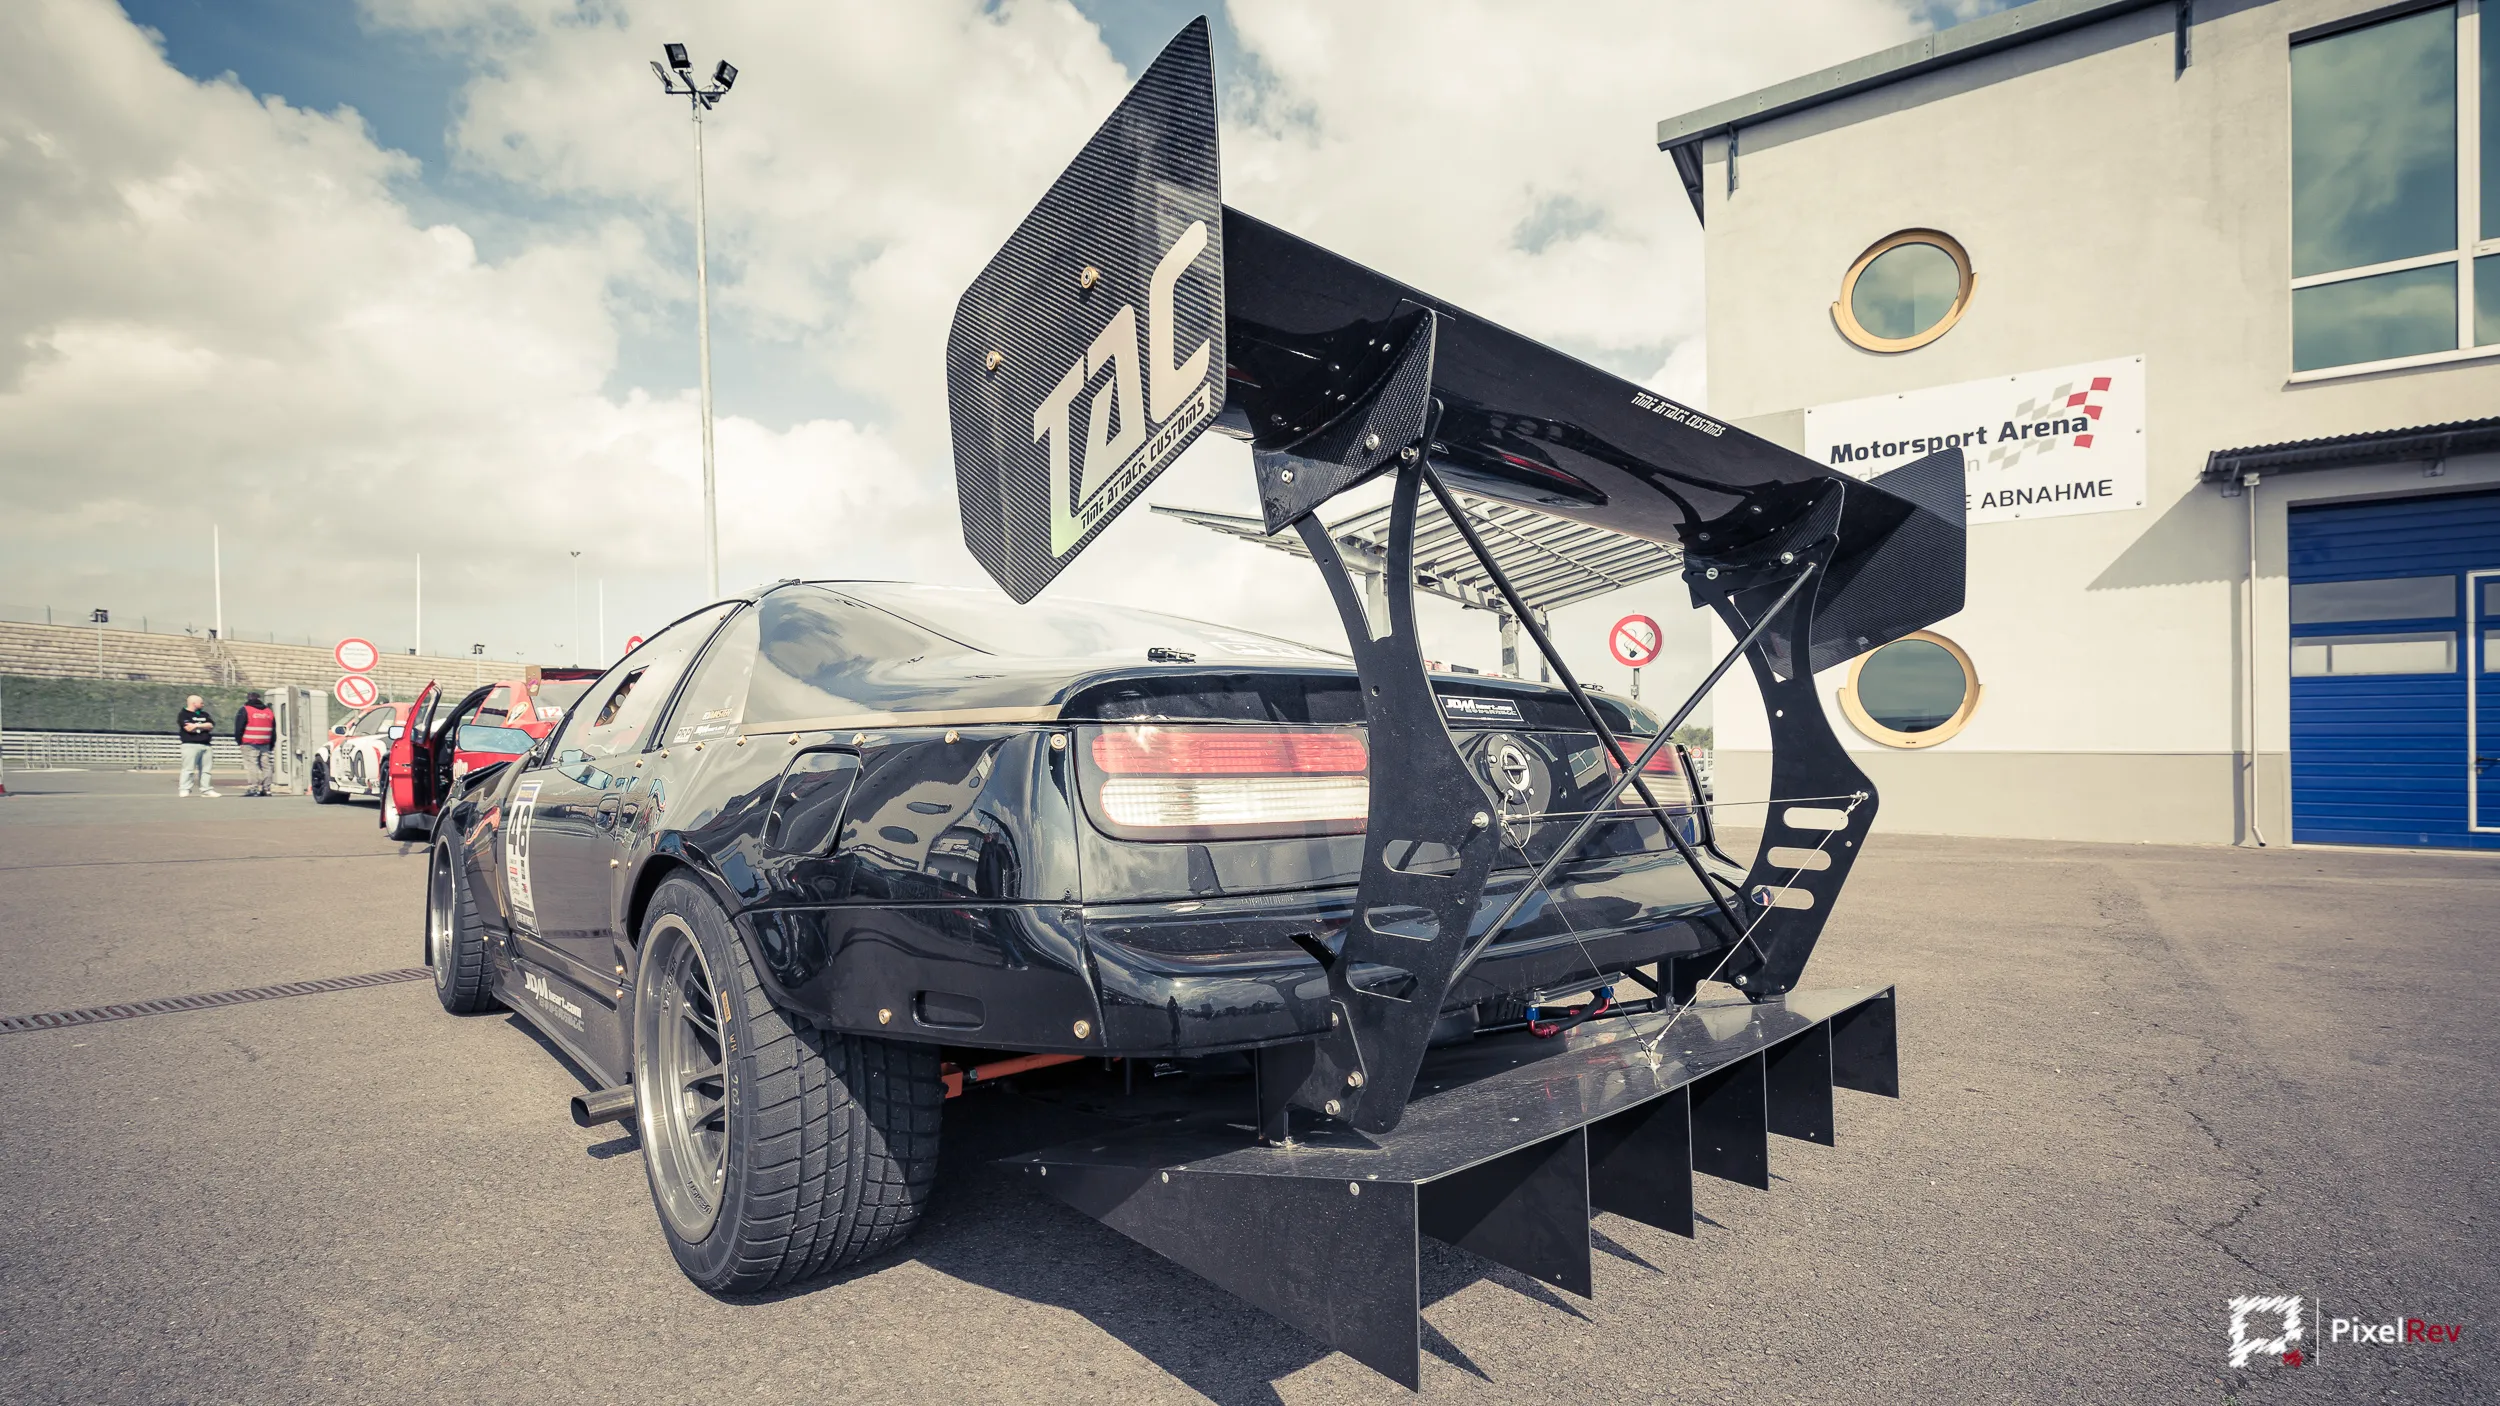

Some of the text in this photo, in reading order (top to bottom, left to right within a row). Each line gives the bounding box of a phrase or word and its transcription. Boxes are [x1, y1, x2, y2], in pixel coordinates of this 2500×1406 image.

[1033, 219, 1211, 559] TAC
[1630, 391, 1727, 438] TIME ATTACK CUSTOMS
[1080, 396, 1205, 530] TIME ATTACK CUSTOMS
[1830, 415, 2089, 465] Motorsport Arena
[1980, 479, 2114, 510] ABNAHME
[508, 804, 531, 858] 48
